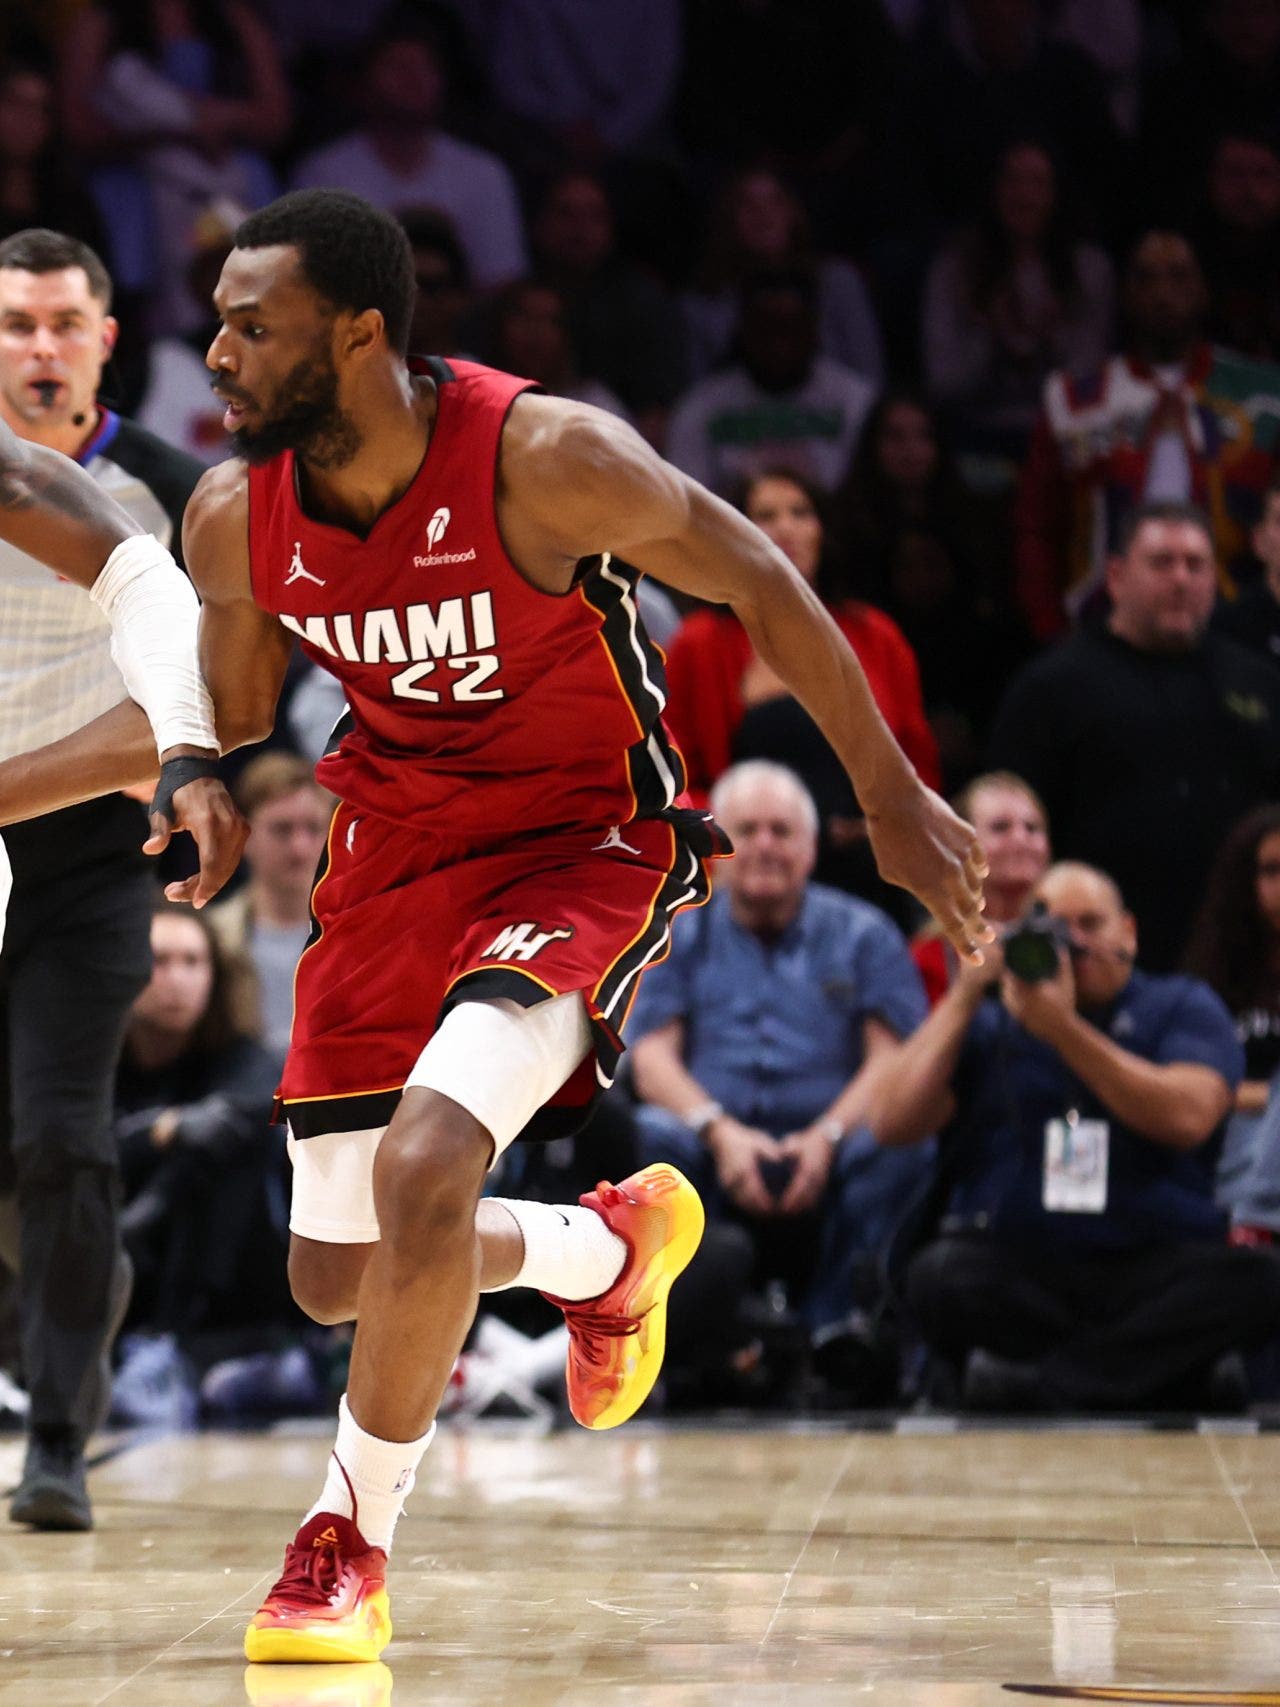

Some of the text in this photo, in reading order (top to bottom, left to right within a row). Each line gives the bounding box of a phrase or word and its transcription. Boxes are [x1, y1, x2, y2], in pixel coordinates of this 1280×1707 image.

[412, 547, 477, 568] Robinhood
[278, 588, 497, 664] MIAMI
[389, 653, 505, 703] 22
